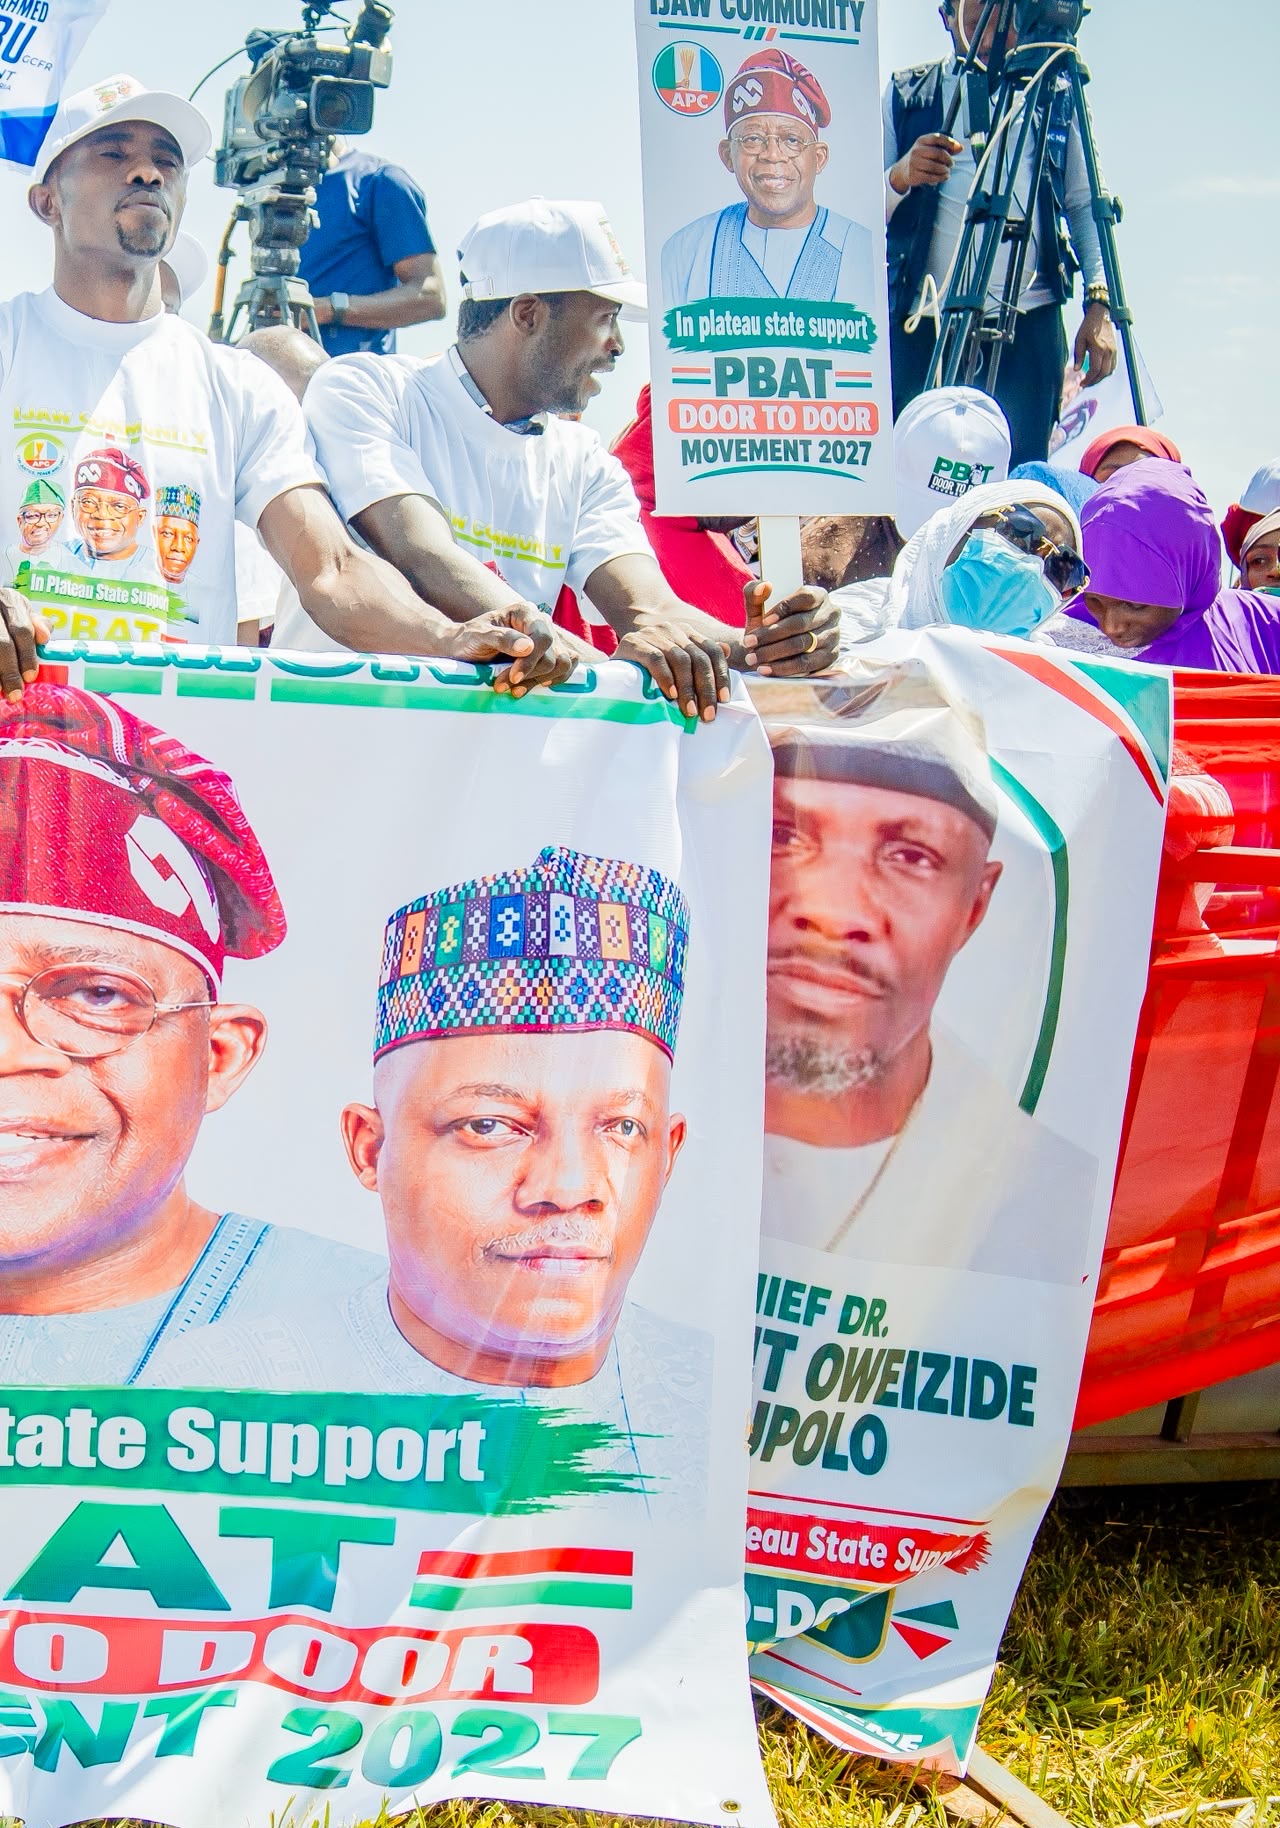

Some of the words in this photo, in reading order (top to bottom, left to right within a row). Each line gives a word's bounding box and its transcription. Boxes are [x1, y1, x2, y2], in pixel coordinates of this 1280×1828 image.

[720, 0, 865, 32] COMMUNITY
[22, 54, 53, 71] GCFR
[671, 93, 709, 109] APC
[676, 310, 694, 337] In
[699, 309, 761, 342] plateau
[765, 311, 805, 338] state
[808, 315, 869, 344] support
[714, 357, 833, 399] PBAT
[14, 405, 72, 424] IJAW
[678, 403, 757, 431] DOOR
[762, 405, 797, 431] TO
[802, 405, 872, 432] DOOR
[681, 439, 812, 466] MOVEMENT
[819, 440, 872, 466] 2027
[932, 476, 954, 491] DOOR
[31, 573, 44, 592] In
[47, 575, 93, 600] Plateau
[96, 584, 128, 603] State
[42, 607, 158, 640] PBAT
[838, 1294, 889, 1338] DR.
[805, 1342, 1038, 1427] OWEIZIDE
[166, 1406, 487, 1485] Support
[806, 1525, 888, 1569] State
[158, 1624, 534, 1696] DOOR
[267, 1707, 642, 1789] 2027
